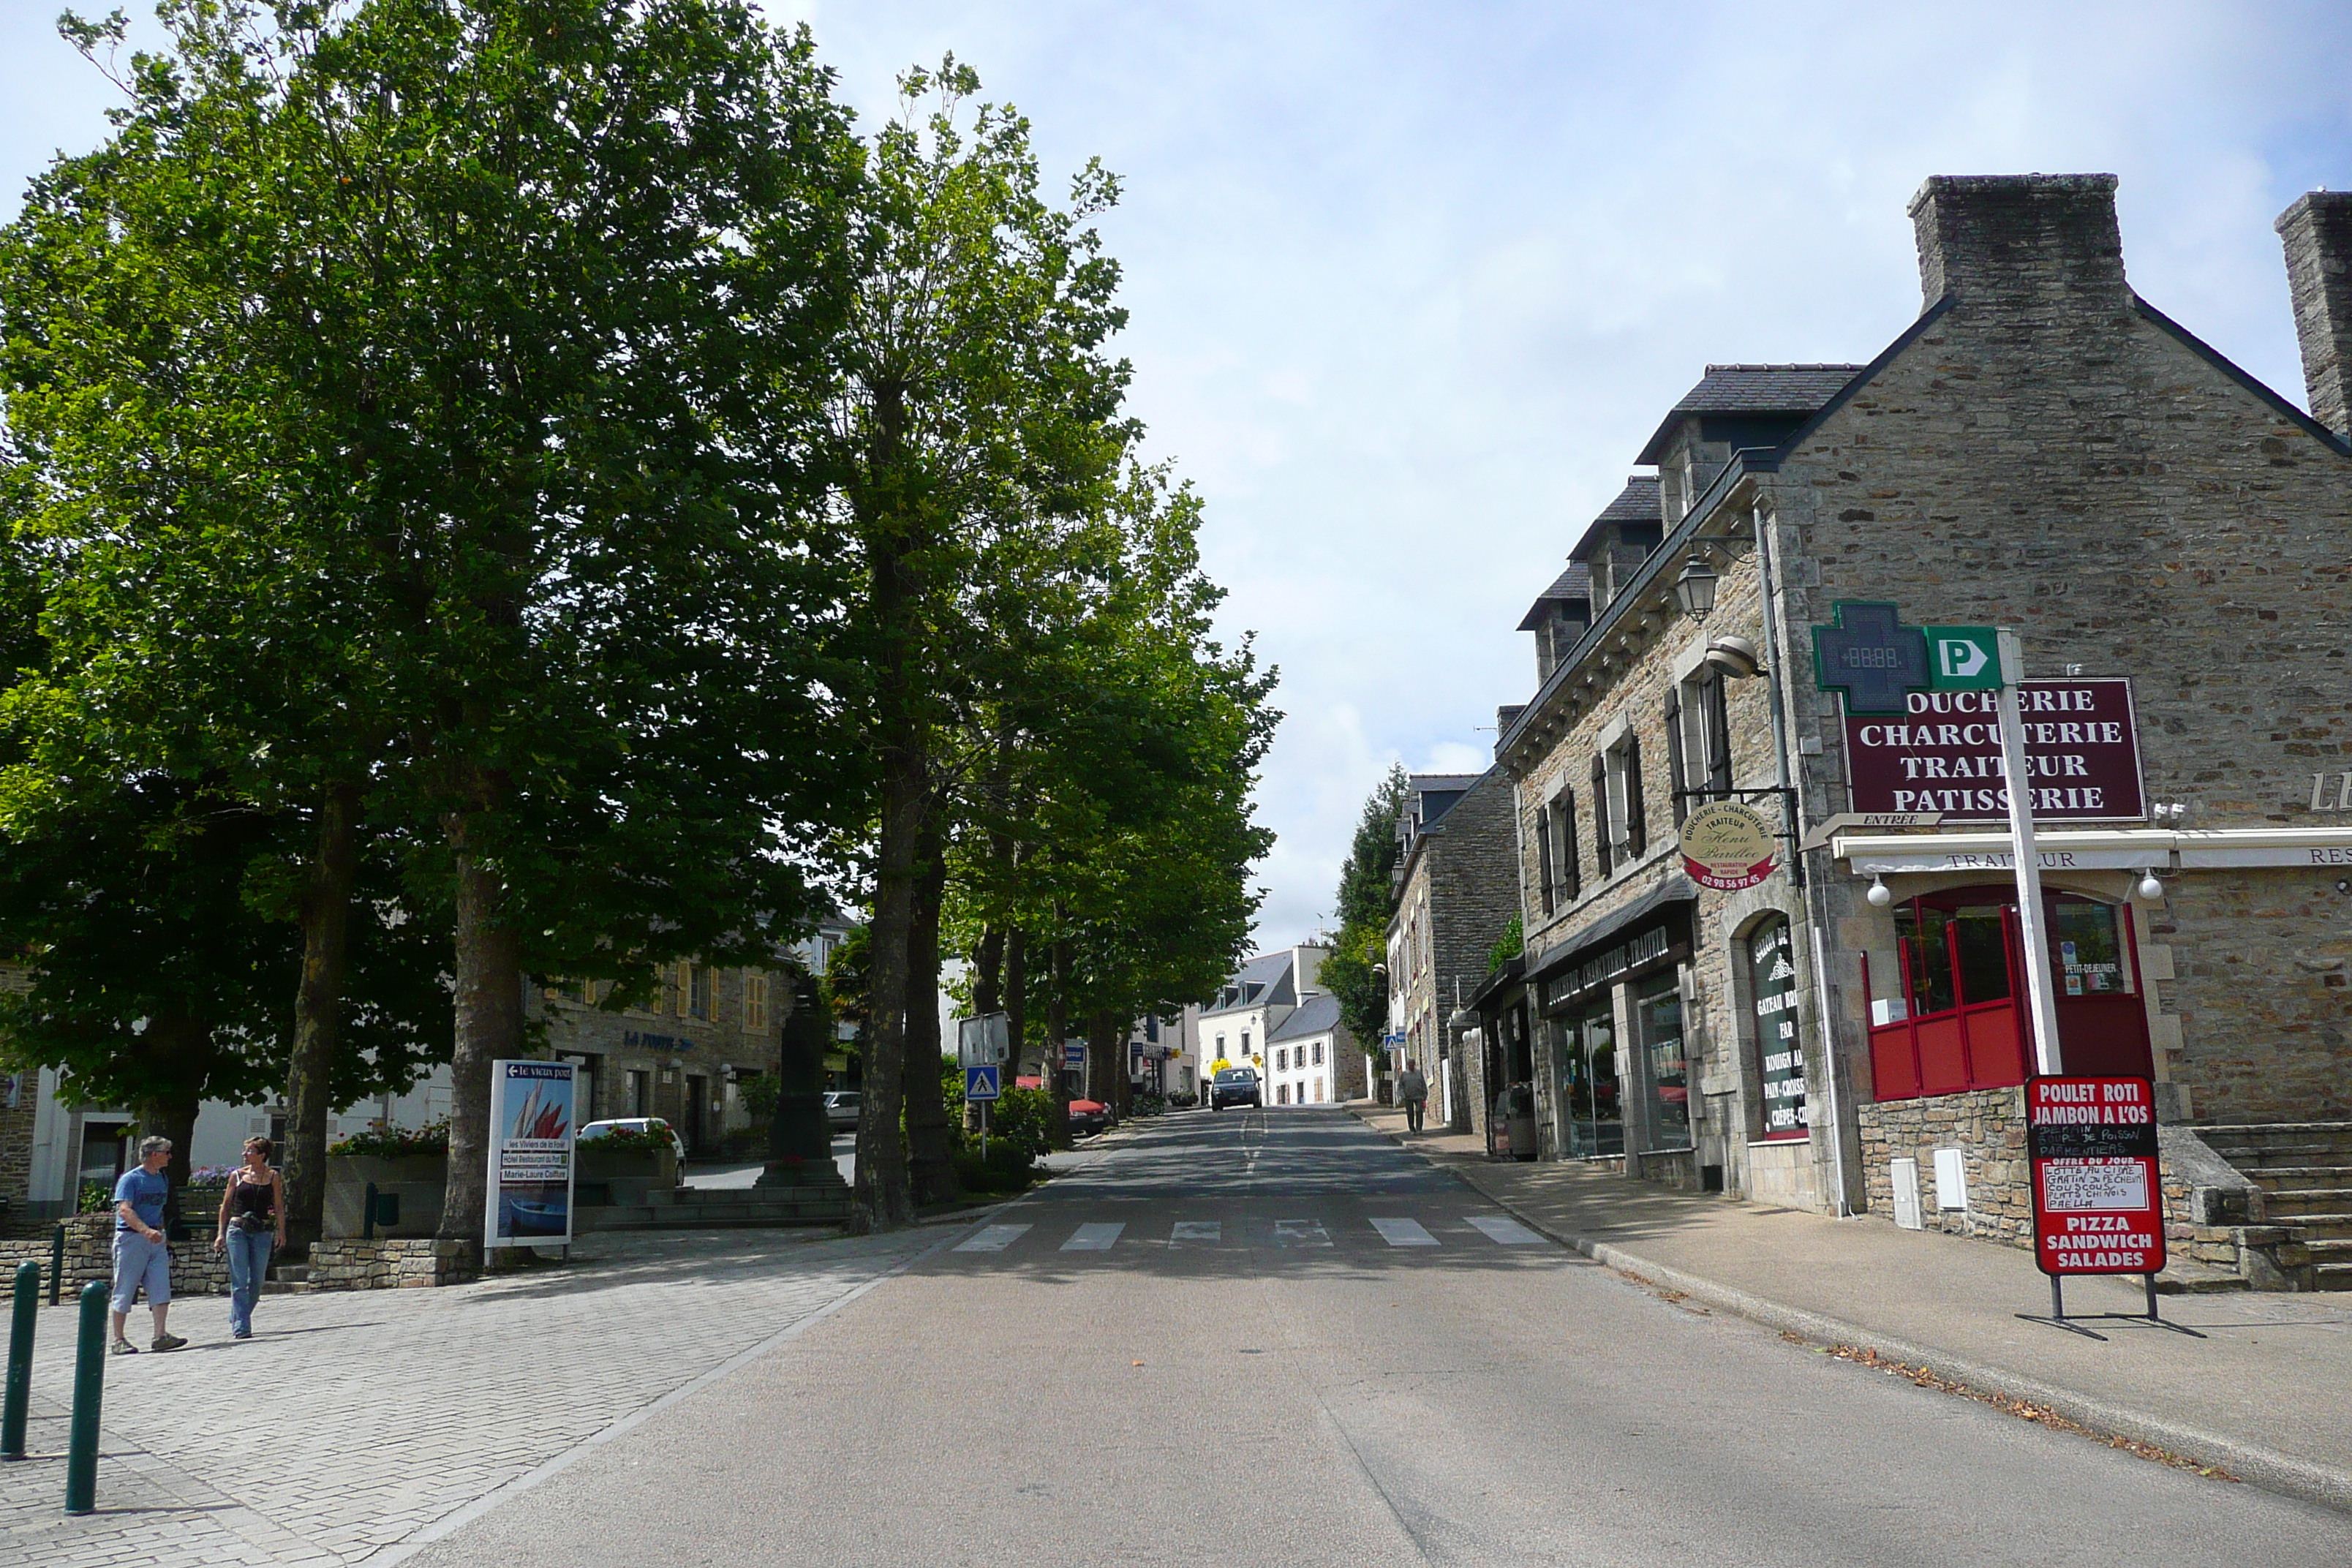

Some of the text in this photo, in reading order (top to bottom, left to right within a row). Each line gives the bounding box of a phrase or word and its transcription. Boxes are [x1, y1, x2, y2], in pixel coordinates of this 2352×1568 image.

[1907, 690, 2095, 714] OUCHERIE
[1860, 722, 2122, 747] CHARCUTERIE
[1901, 755, 2089, 778] TRAITEUR
[1684, 806, 1716, 841] BOUCHERIE
[1723, 804, 1769, 840] CHARCUTERIE
[1705, 817, 1745, 830] TRAITEUR
[1946, 853, 2076, 867] TRAIUR
[1701, 875, 1712, 886] 02
[1714, 878, 1725, 888] 98
[1726, 879, 1737, 889] 56
[1738, 878, 1748, 888] 97
[1755, 926, 1788, 964] SALON DE
[1757, 994, 1783, 1017] GATEAU
[1779, 1021, 1793, 1039] FAR
[1765, 1051, 1792, 1073] KOUIGN
[2040, 1083, 2138, 1102] POULET ROTI
[2033, 1105, 2148, 1125] JAMBON A L'OS
[2081, 1134, 2097, 1142] DE
[2052, 1157, 2136, 1166] OFFRE DU JOUR
[2047, 1173, 2088, 1185] GRATIN
[2067, 1217, 2130, 1232] PIZZA
[2047, 1234, 2152, 1250] SANDWICH
[2058, 1252, 2144, 1267] SALADES
